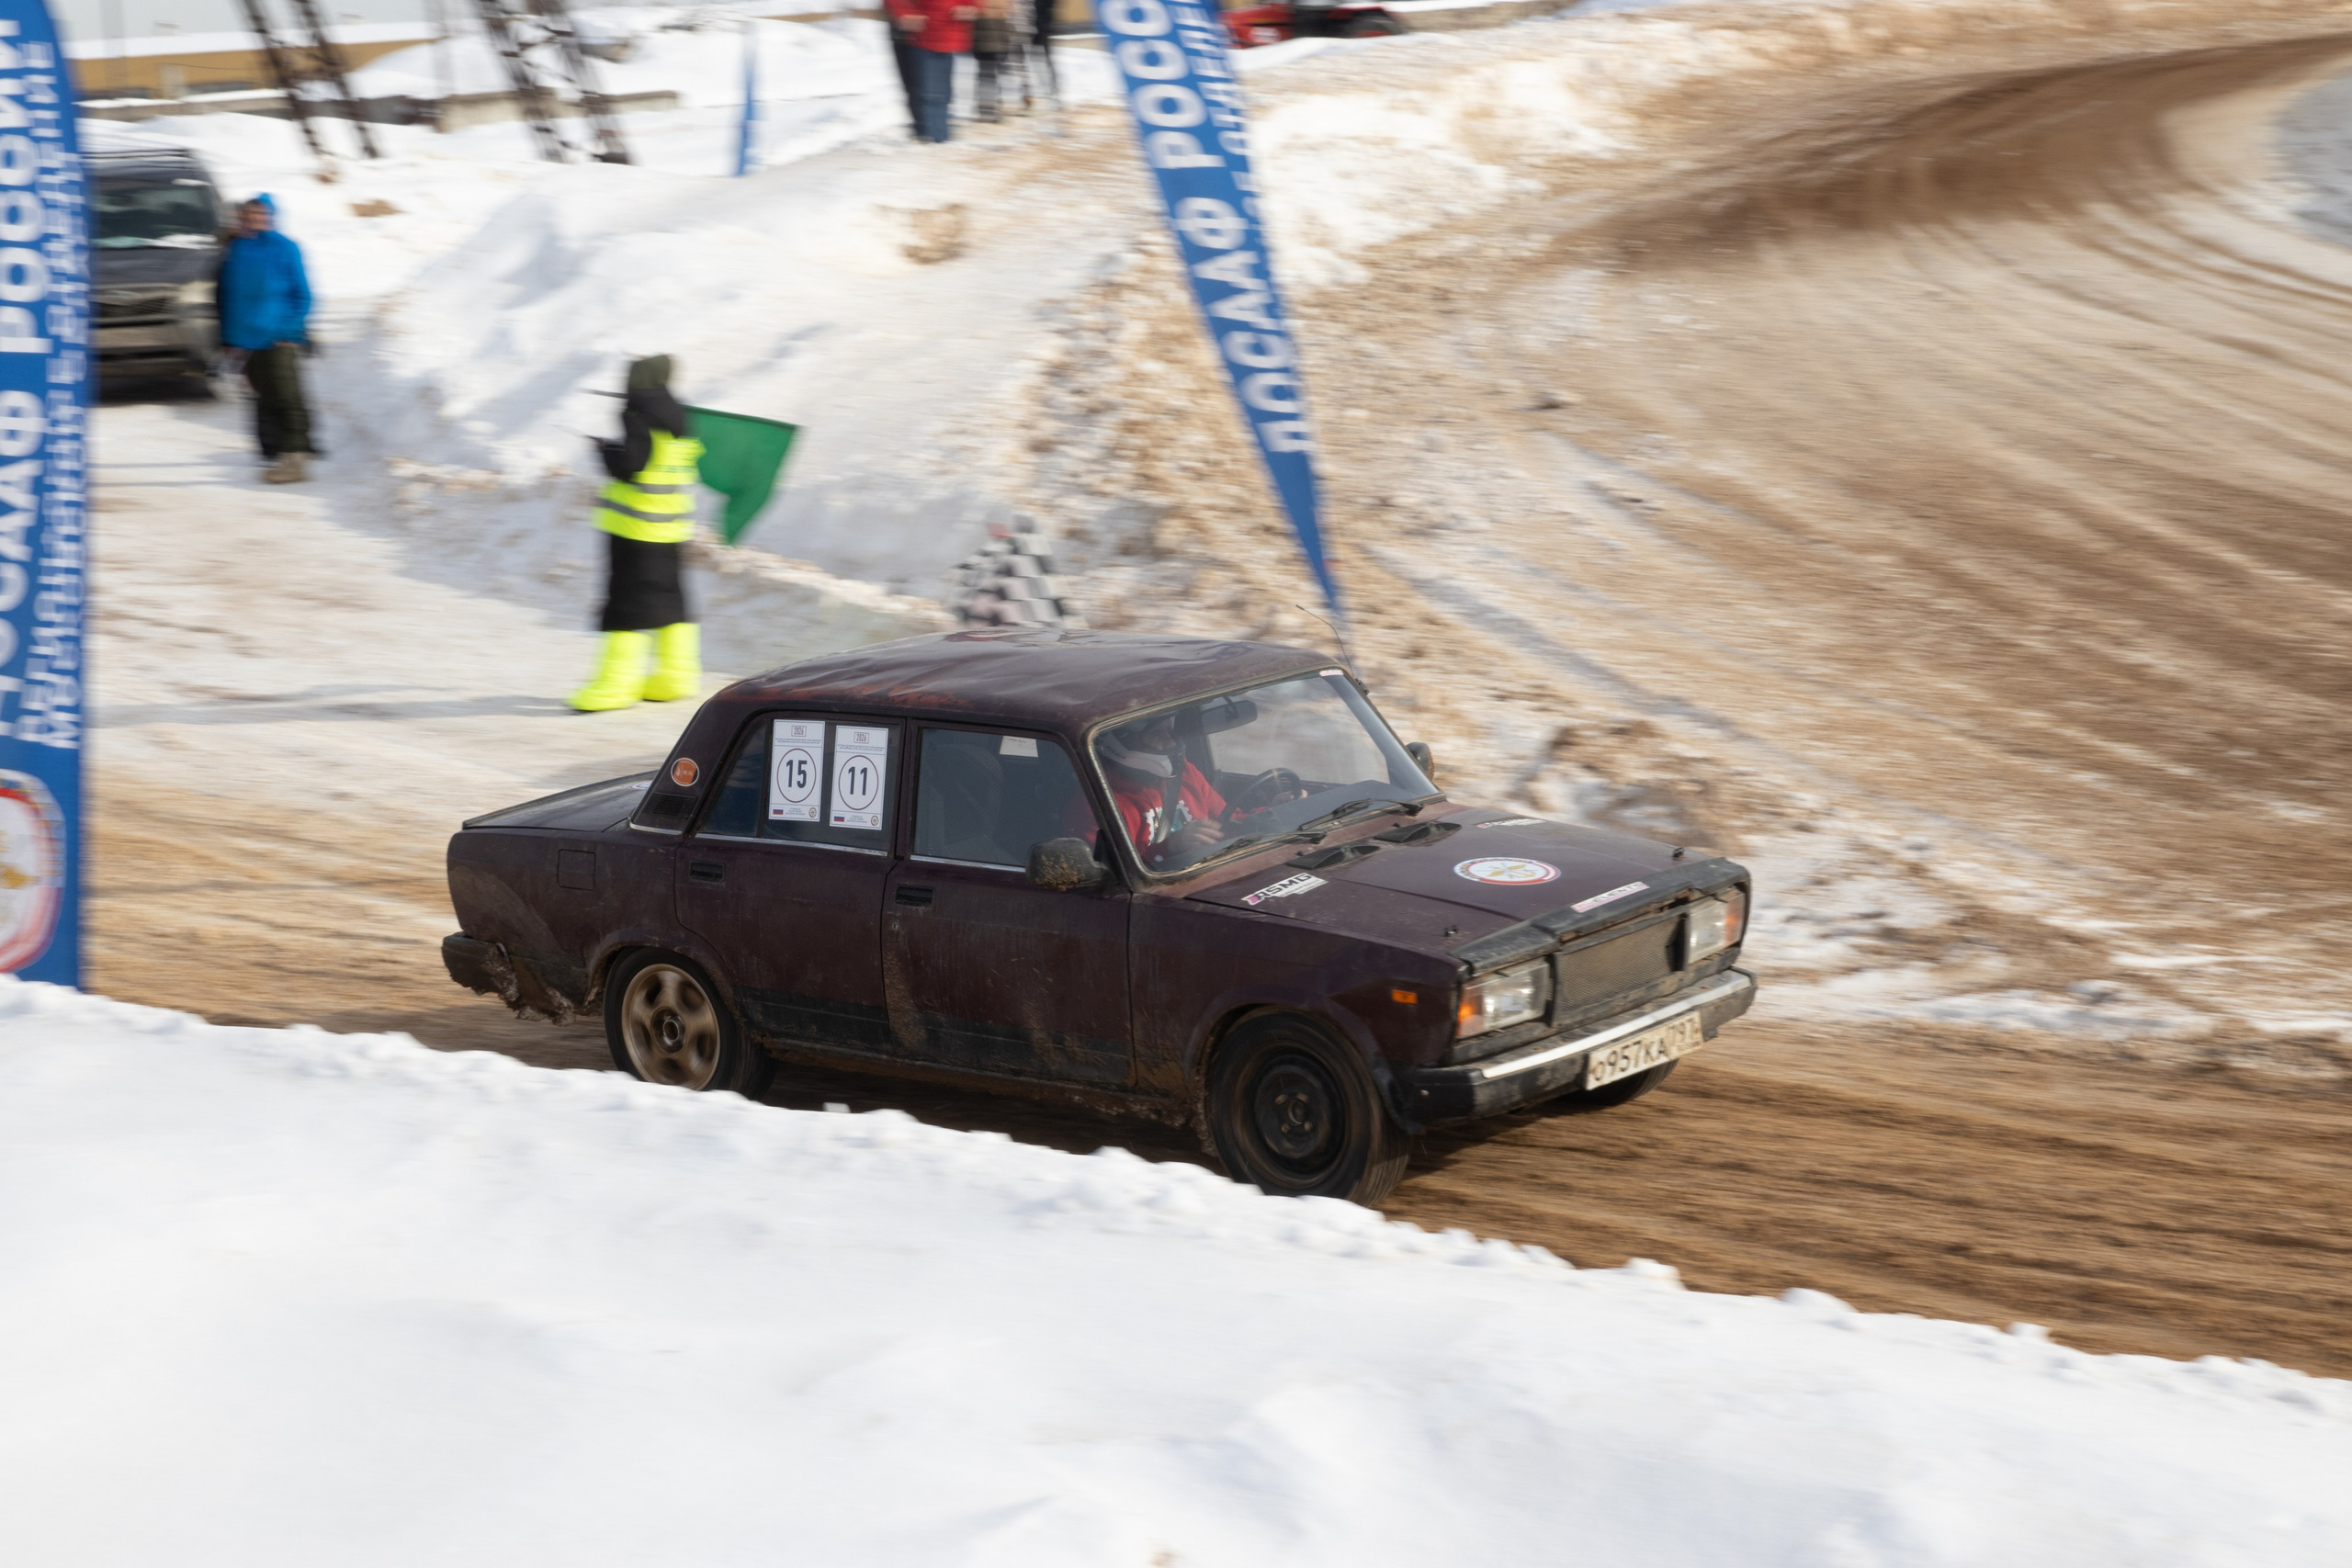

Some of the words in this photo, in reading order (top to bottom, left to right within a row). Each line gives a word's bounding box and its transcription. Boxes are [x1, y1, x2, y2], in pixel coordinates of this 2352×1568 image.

[0, 20, 53, 354] РОСС
[17, 41, 77, 337] ОТДЕЛЕНИЕ
[1170, 196, 1311, 453] ДОСААФ
[786, 759, 808, 789] 15
[848, 766, 868, 796] 11
